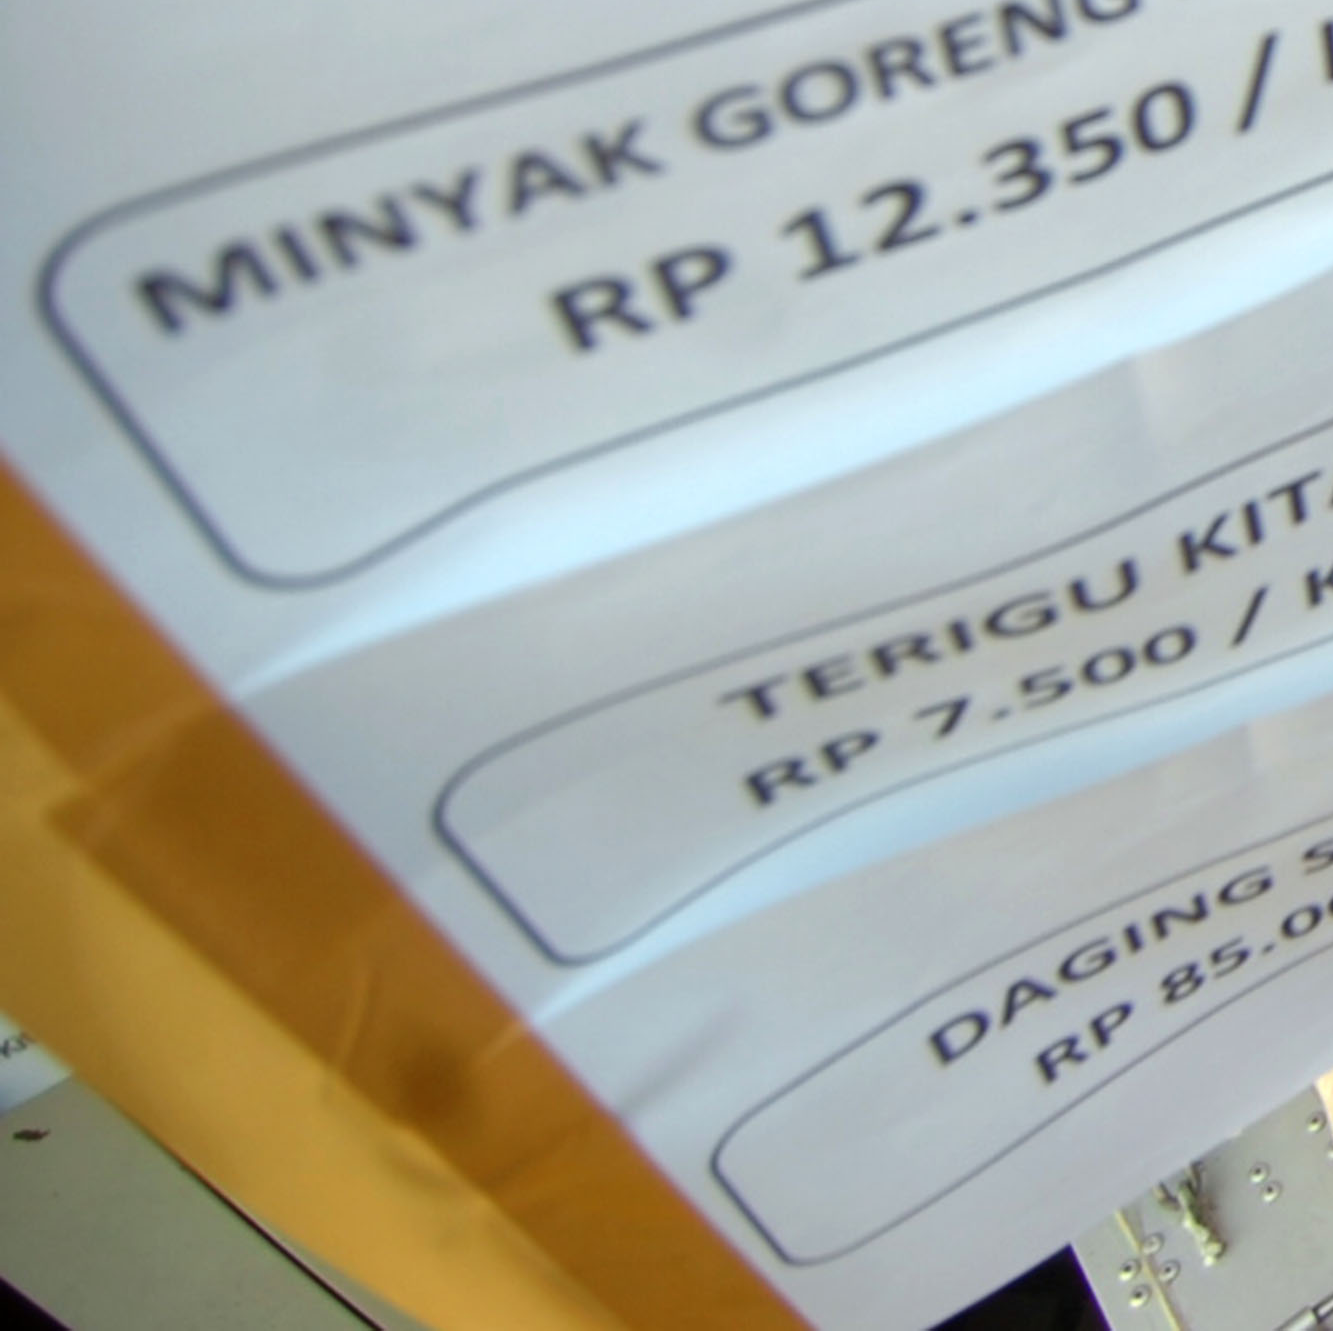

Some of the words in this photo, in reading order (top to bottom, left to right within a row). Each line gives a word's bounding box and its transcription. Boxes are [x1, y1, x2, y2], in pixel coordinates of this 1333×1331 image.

[131, 121, 661, 338] MINYAK
[549, 244, 734, 355] RP
[783, 79, 1199, 282] 12.350
[1234, 30, 1281, 137] /
[722, 556, 1142, 723] TERIGU
[742, 729, 882, 809] RP
[918, 622, 1200, 741] 7.500
[1229, 583, 1271, 649] /
[925, 873, 1277, 1069] DAGING
[1032, 999, 1136, 1087] RP
